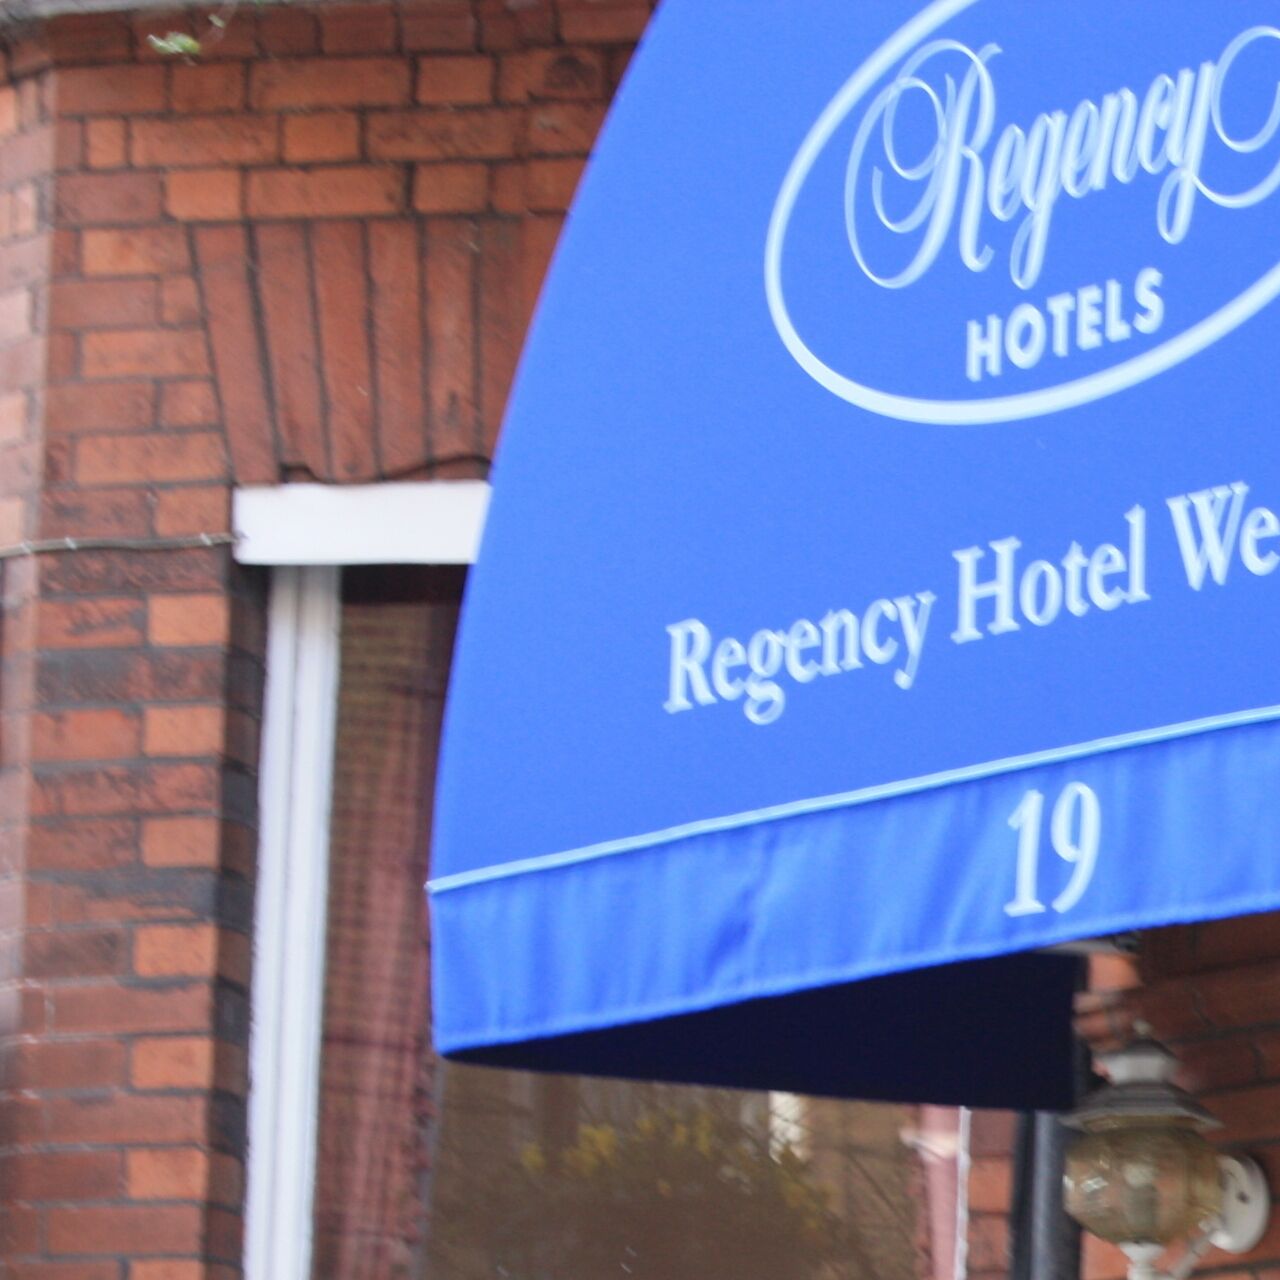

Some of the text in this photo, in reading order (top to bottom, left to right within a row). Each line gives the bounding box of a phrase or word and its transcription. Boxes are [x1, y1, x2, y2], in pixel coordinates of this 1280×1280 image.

[966, 267, 1164, 381] HOTELS
[662, 591, 937, 725] Regency
[950, 504, 1151, 645] Hotel
[1003, 780, 1102, 918] 19
